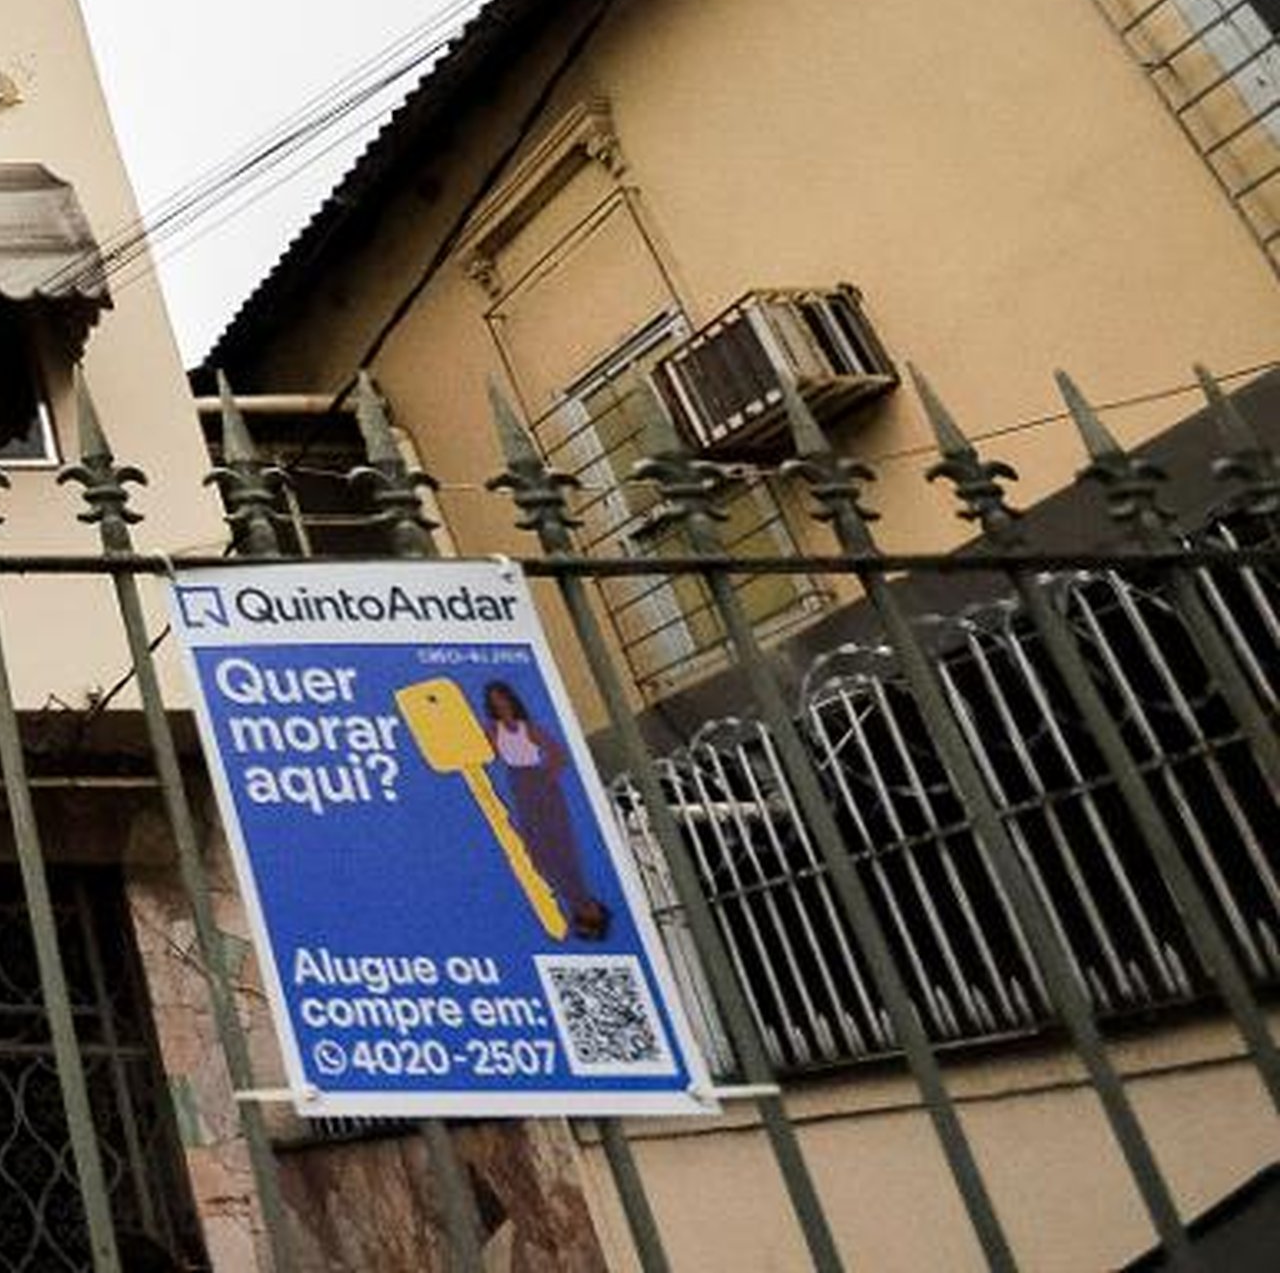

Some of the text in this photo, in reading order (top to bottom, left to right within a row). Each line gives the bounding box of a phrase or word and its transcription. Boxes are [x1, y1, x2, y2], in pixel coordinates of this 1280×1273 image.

[235, 586, 518, 624] QuintoAndar
[215, 658, 357, 706] Quer
[229, 714, 400, 753] morar
[244, 753, 400, 815] aqui?
[294, 947, 500, 994] Alugue ou
[300, 996, 548, 1035] compre em:
[351, 1039, 556, 1076] 4020-2507
